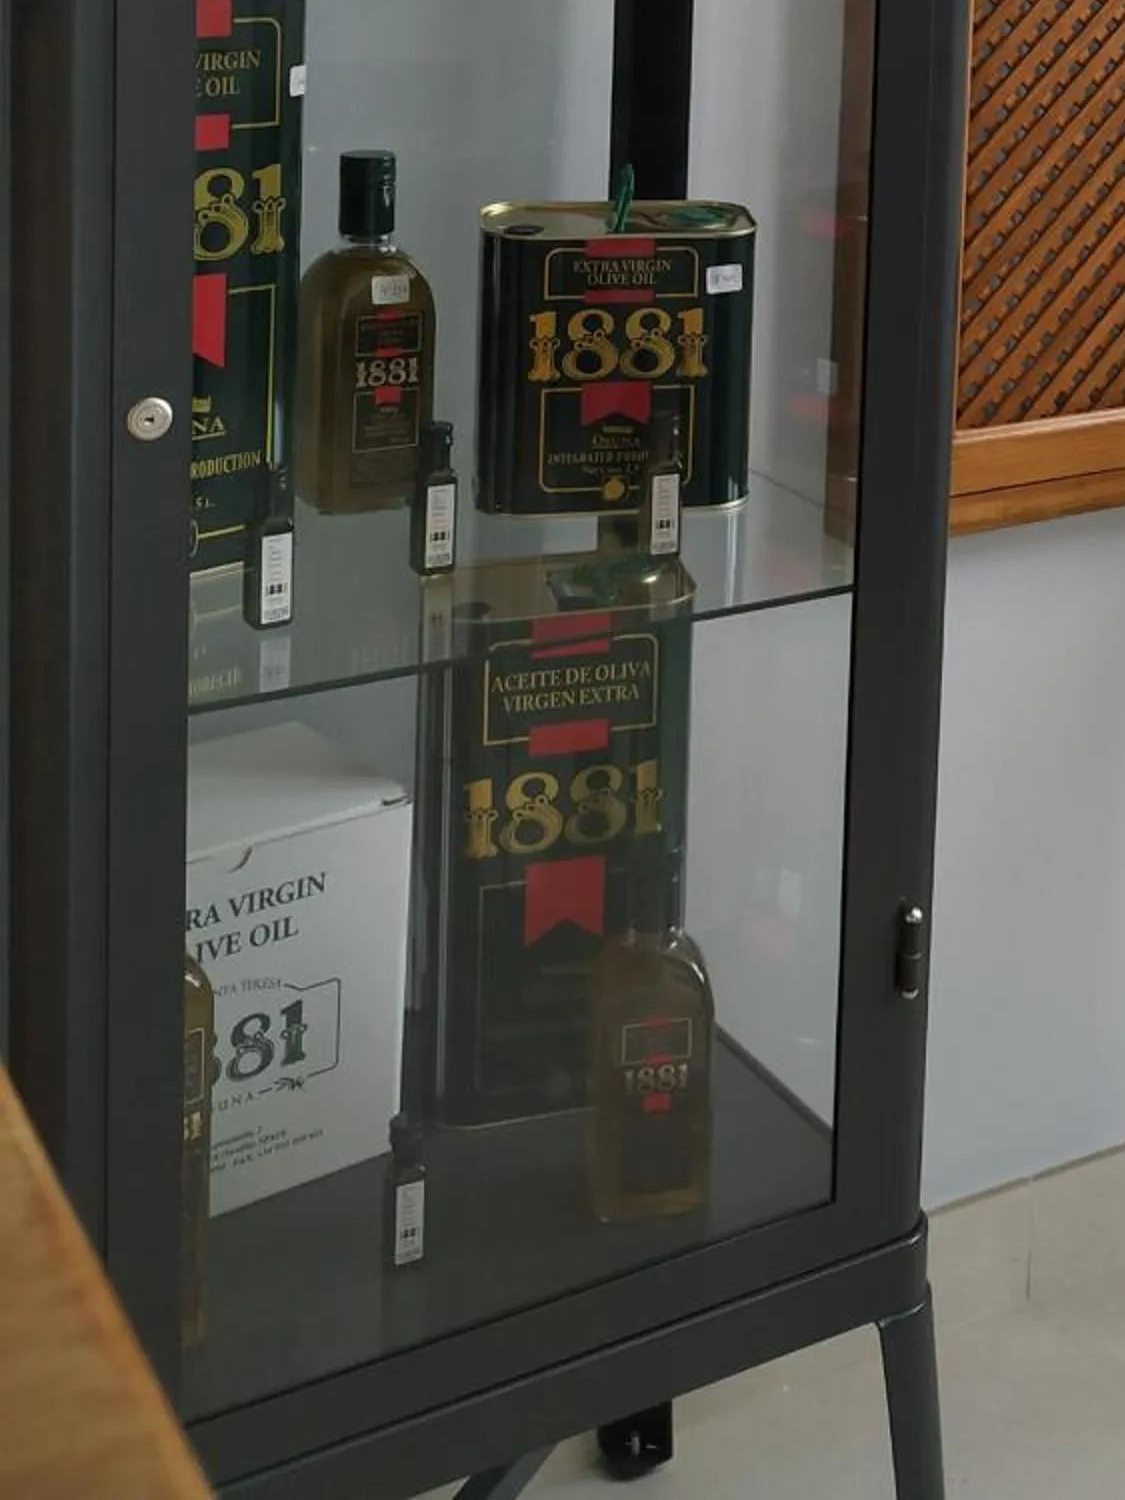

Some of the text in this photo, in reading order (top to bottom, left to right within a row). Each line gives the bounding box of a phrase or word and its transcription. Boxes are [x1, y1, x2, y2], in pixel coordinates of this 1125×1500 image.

[205, 76, 240, 97] OIL
[574, 259, 672, 274] EXTRA VIRGIN
[587, 273, 657, 286] OLIVE OIL
[527, 307, 709, 383] 1881
[355, 357, 419, 389] 1881
[491, 660, 652, 693] ACEITE DE OLIVA
[502, 683, 641, 713] VIRGEN EXTRA
[464, 759, 664, 859] 1881
[228, 871, 326, 918] VIRGIN
[249, 916, 299, 948] OIL
[213, 999, 308, 1086] 81
[623, 1063, 688, 1096] 1881
